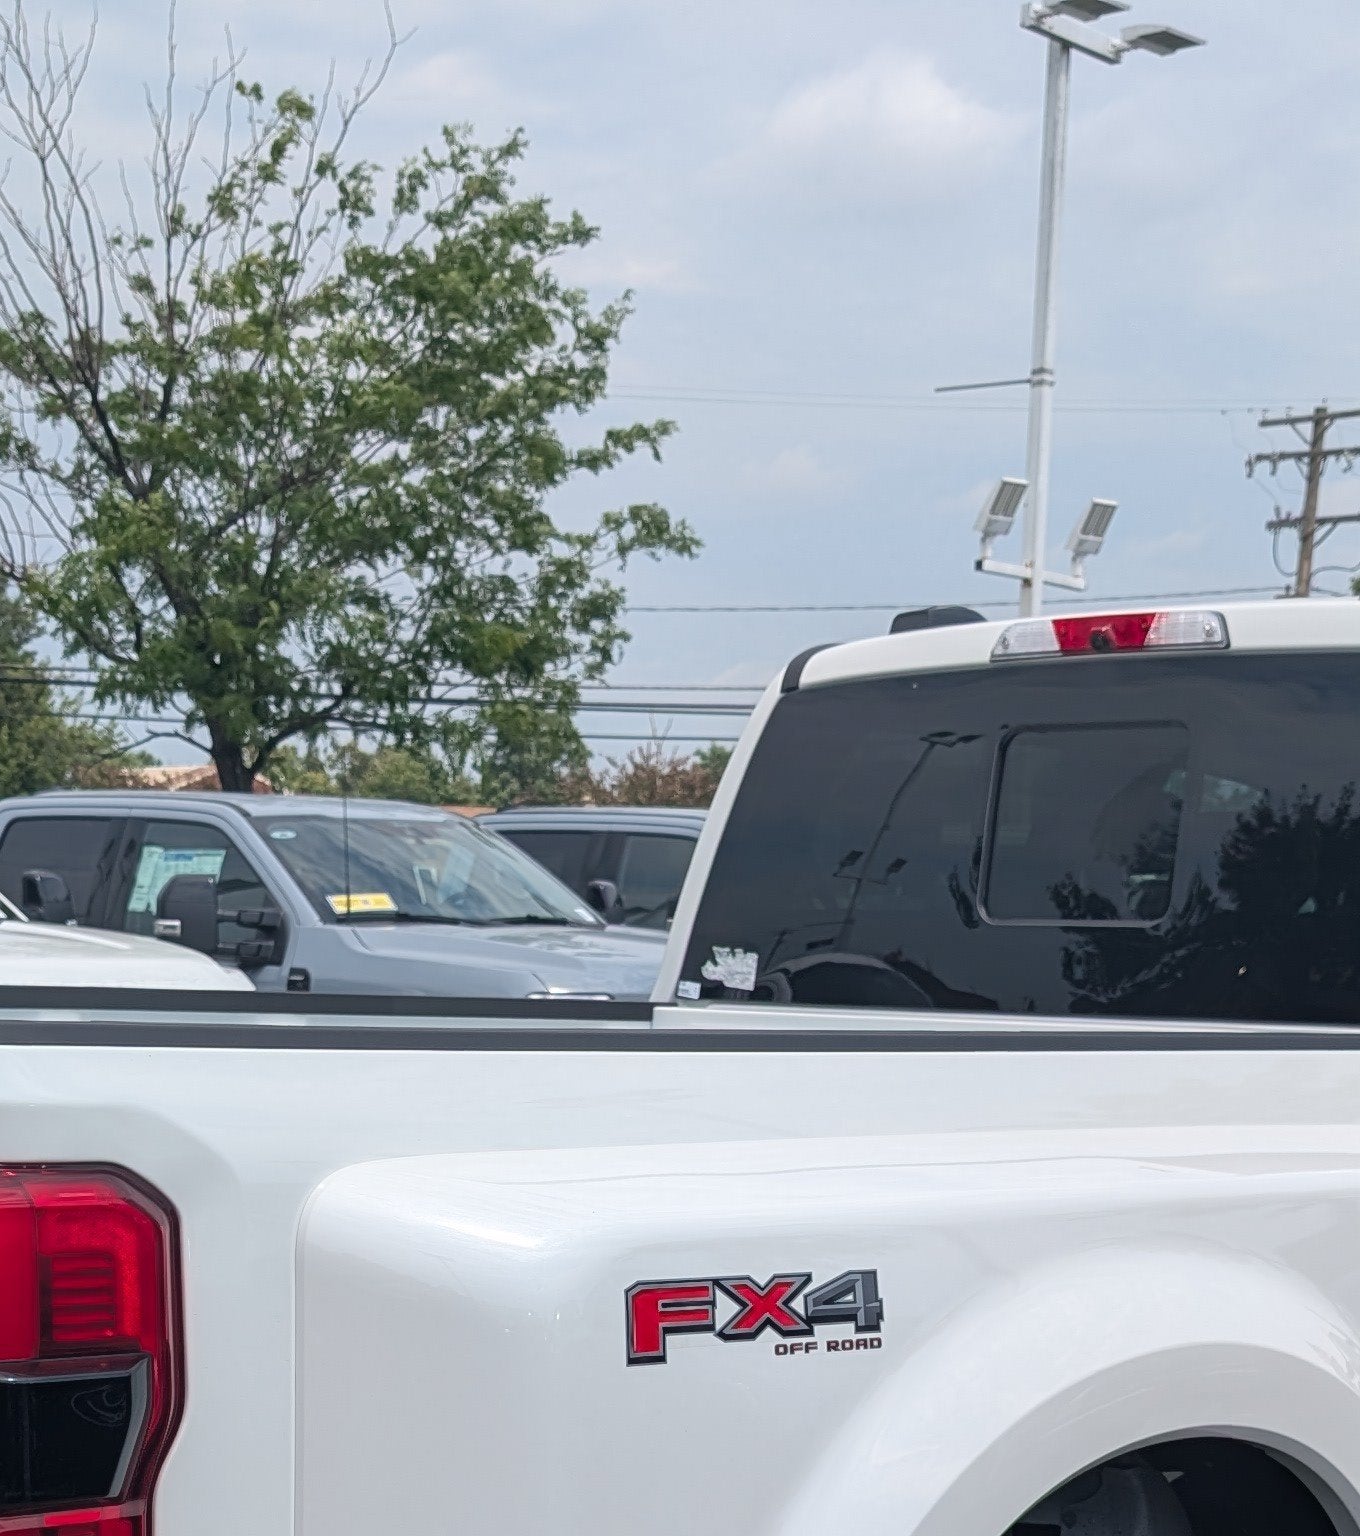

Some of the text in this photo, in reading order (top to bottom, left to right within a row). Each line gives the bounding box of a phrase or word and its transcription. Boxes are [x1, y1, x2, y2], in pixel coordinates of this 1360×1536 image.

[624, 1269, 884, 1367] FX4
[774, 1336, 882, 1356] OFF ROAD
